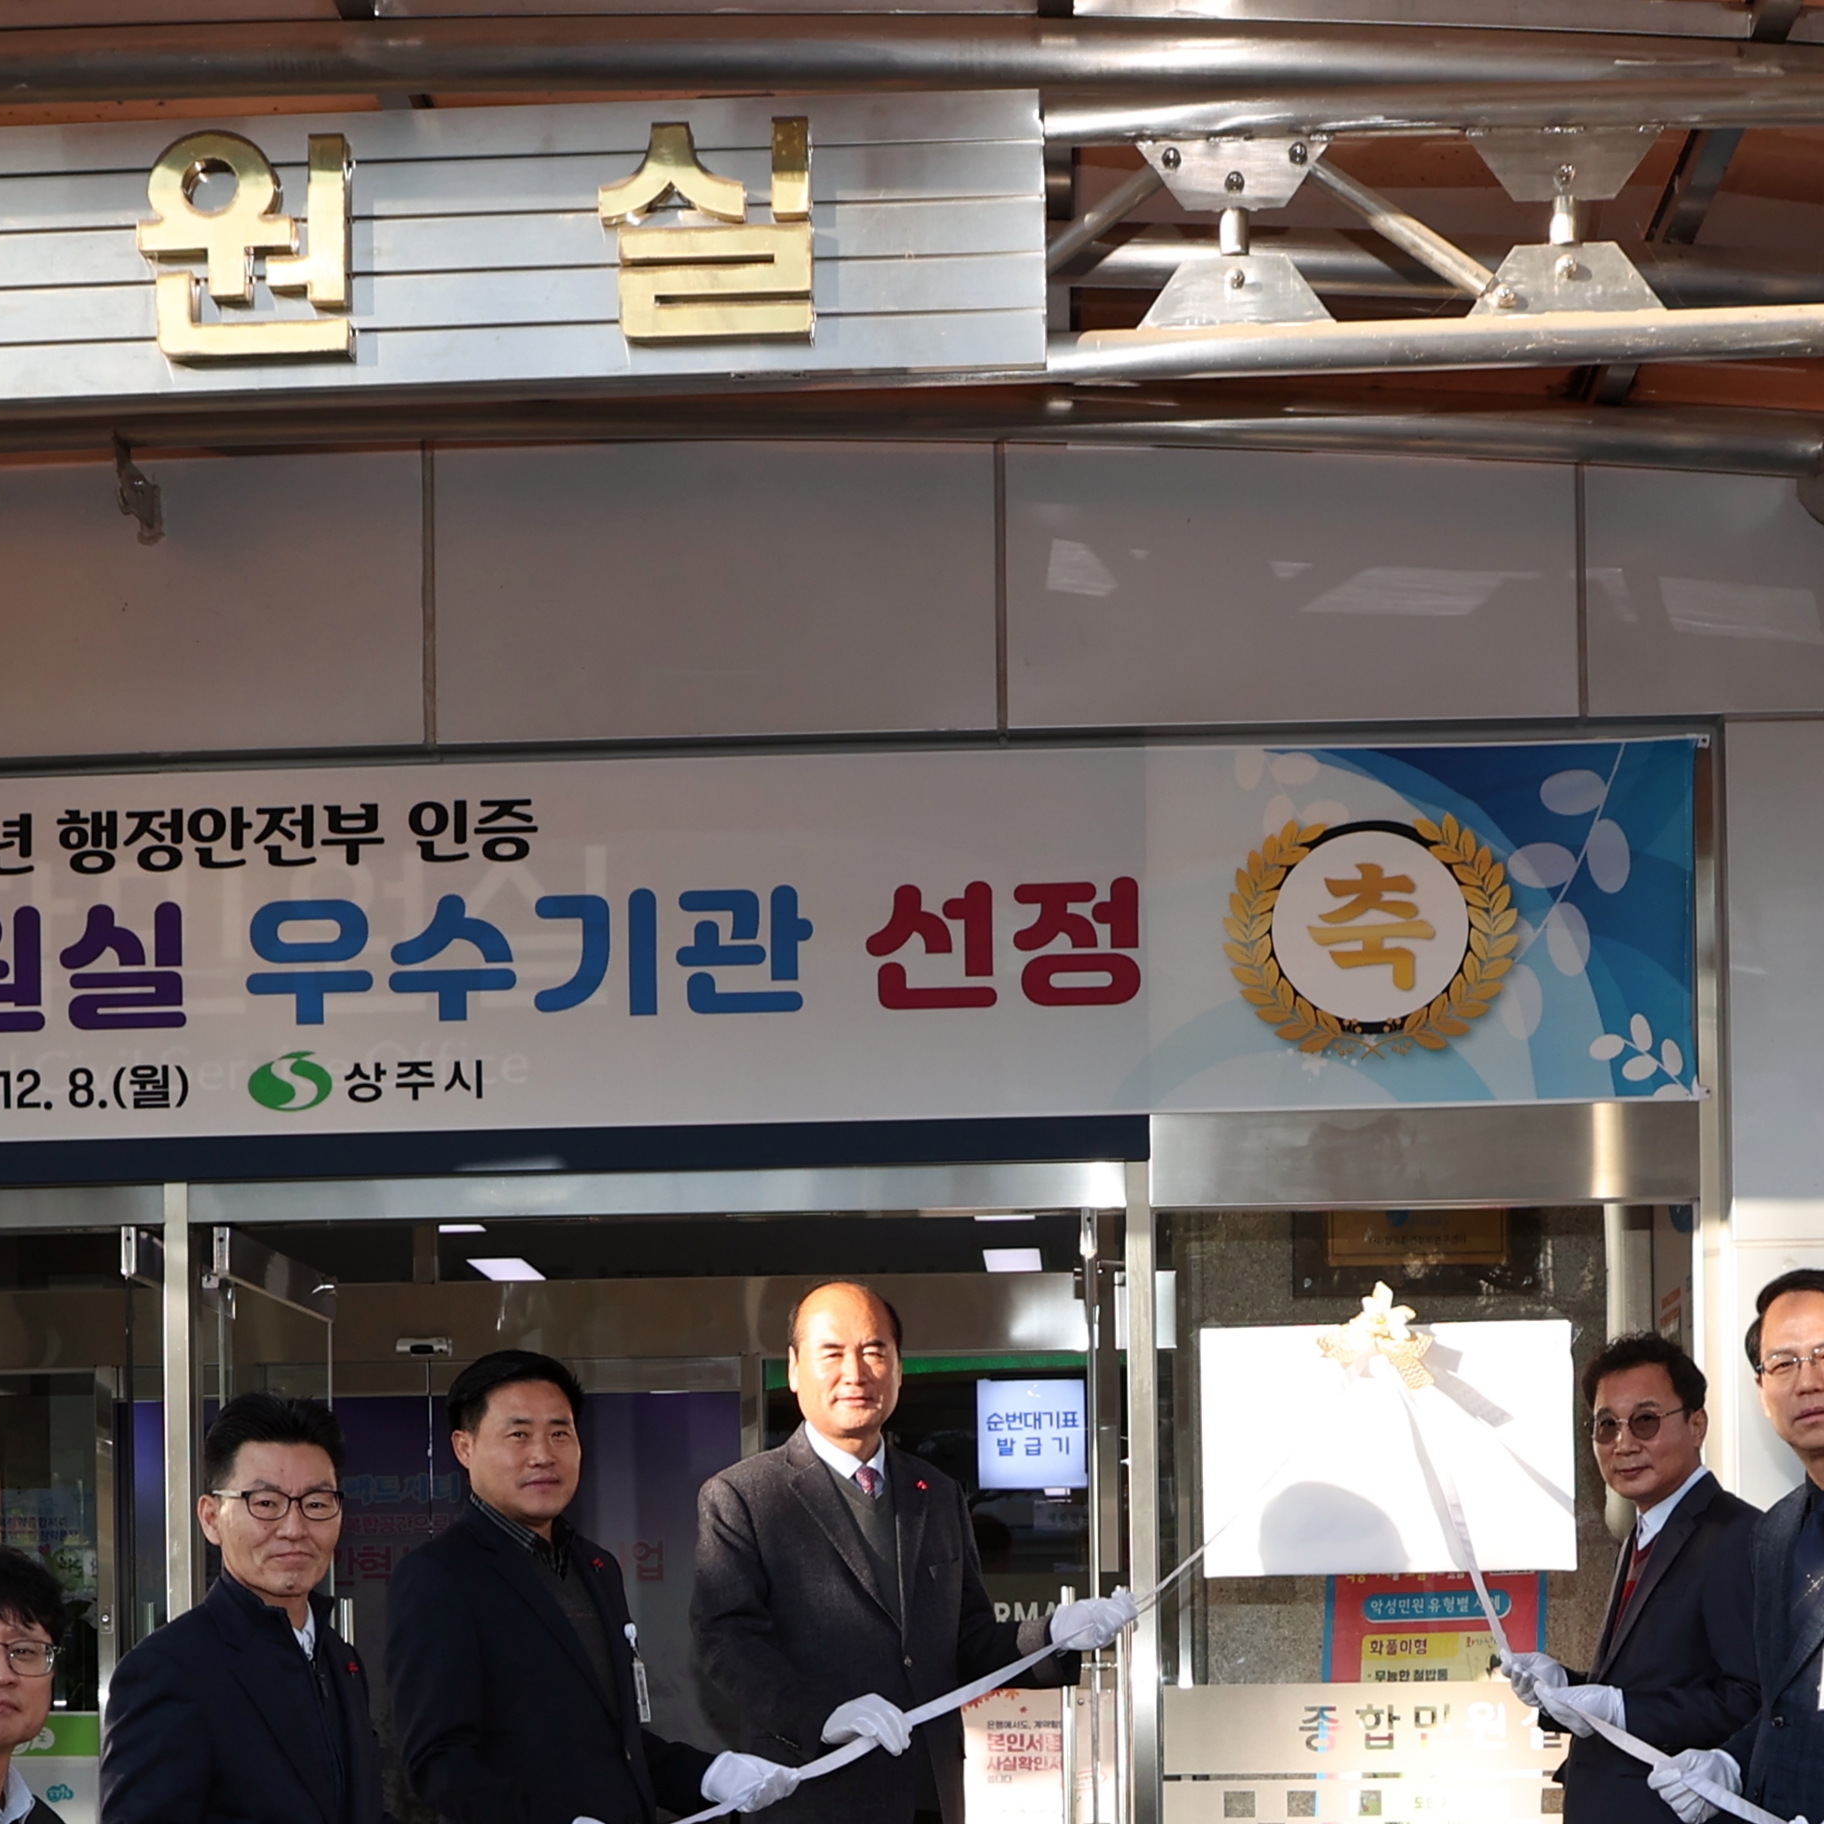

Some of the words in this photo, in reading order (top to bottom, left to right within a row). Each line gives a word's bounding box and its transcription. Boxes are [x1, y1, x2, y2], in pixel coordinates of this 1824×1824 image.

[57, 803, 385, 875] 행정안전부
[408, 798, 538, 863] 인증
[1306, 861, 1436, 990] 축
[245, 885, 813, 1025] 우수기관
[864, 875, 1142, 1011] 선정
[344, 1060, 485, 1102] 상주시
[986, 1410, 1080, 1432] 순번대기표
[996, 1436, 1071, 1457] 발급기
[1370, 1597, 1425, 1616] 악성민원
[1427, 1595, 1470, 1614] 유형별
[1369, 1638, 1428, 1656] 화풀이형
[1374, 1668, 1410, 1682] 무능한
